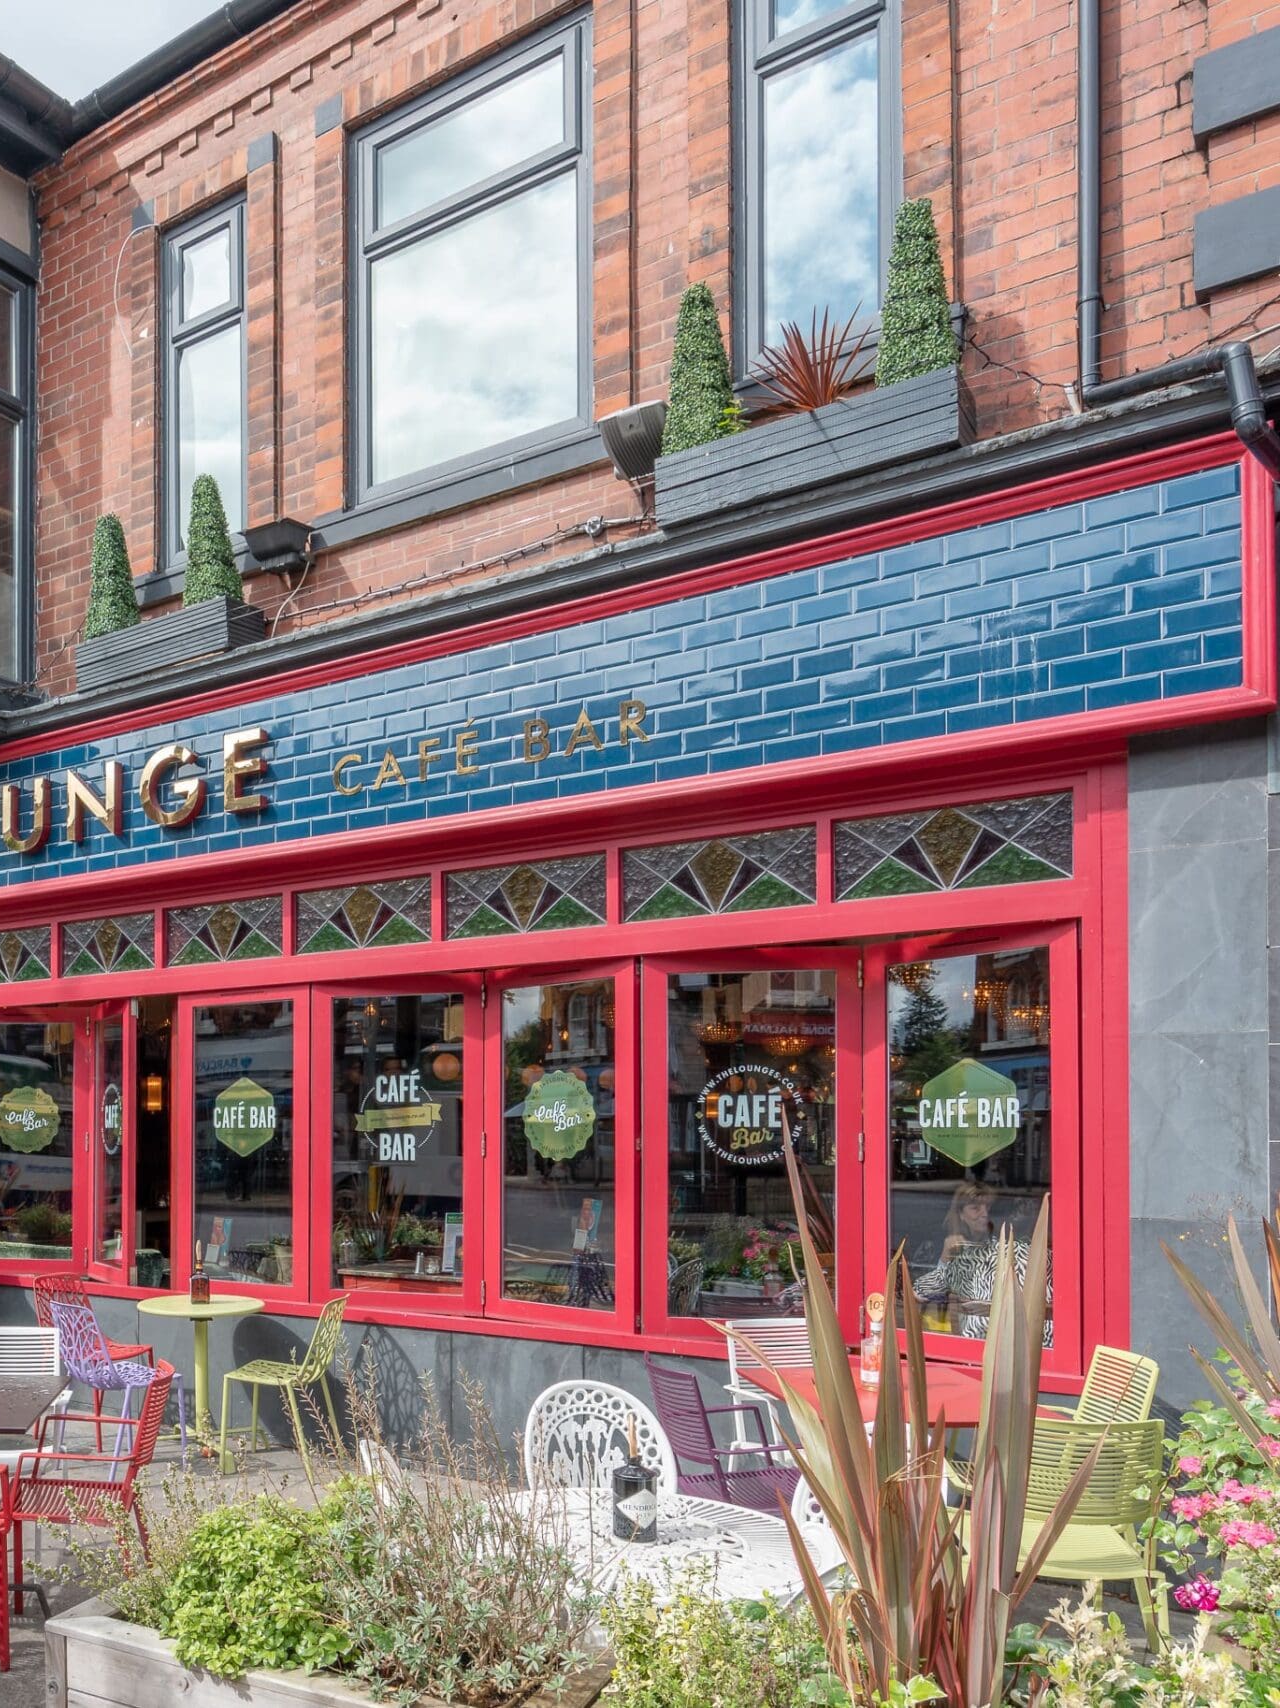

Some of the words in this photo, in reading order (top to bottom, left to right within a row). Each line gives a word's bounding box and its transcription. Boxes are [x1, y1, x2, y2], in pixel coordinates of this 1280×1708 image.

[332, 717, 480, 796] CAFÉ
[523, 699, 650, 764] BAR
[375, 1068, 421, 1102] CAFÉ
[697, 1064, 804, 1104] WWW.THELOUNGES.CO.UK
[4, 1108, 36, 1125] Café
[104, 1098, 119, 1129] CAFÉ
[213, 1101, 245, 1129] CAFÉ
[249, 1106, 276, 1129] BAR
[534, 1100, 568, 1123] Café
[717, 1086, 783, 1128] CAFÉ
[919, 1090, 969, 1128] CAFÉ
[977, 1097, 1021, 1128] BAR
[24, 1117, 50, 1132] Bar
[554, 1114, 583, 1132] Bar
[379, 1133, 416, 1161] BAR
[730, 1128, 775, 1150] Bar
